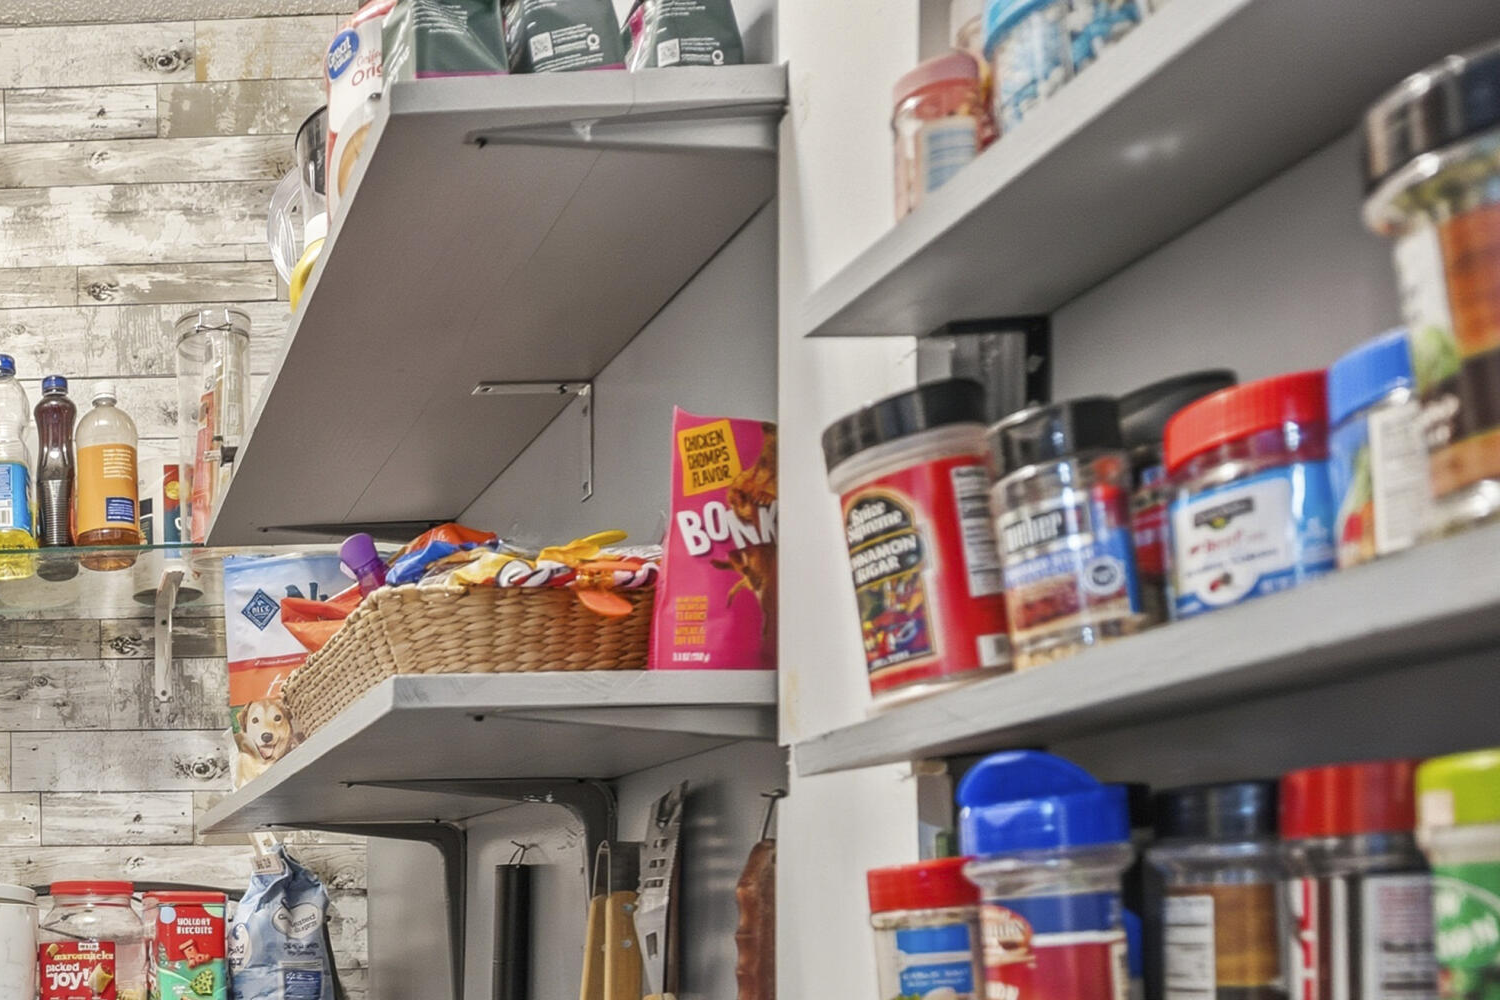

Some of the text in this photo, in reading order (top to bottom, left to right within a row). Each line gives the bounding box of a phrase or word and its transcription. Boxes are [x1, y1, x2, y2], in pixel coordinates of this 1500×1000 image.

[683, 428, 726, 452] CHICKEN
[687, 445, 731, 470] CHOMPS
[692, 465, 733, 489] FLAVOR
